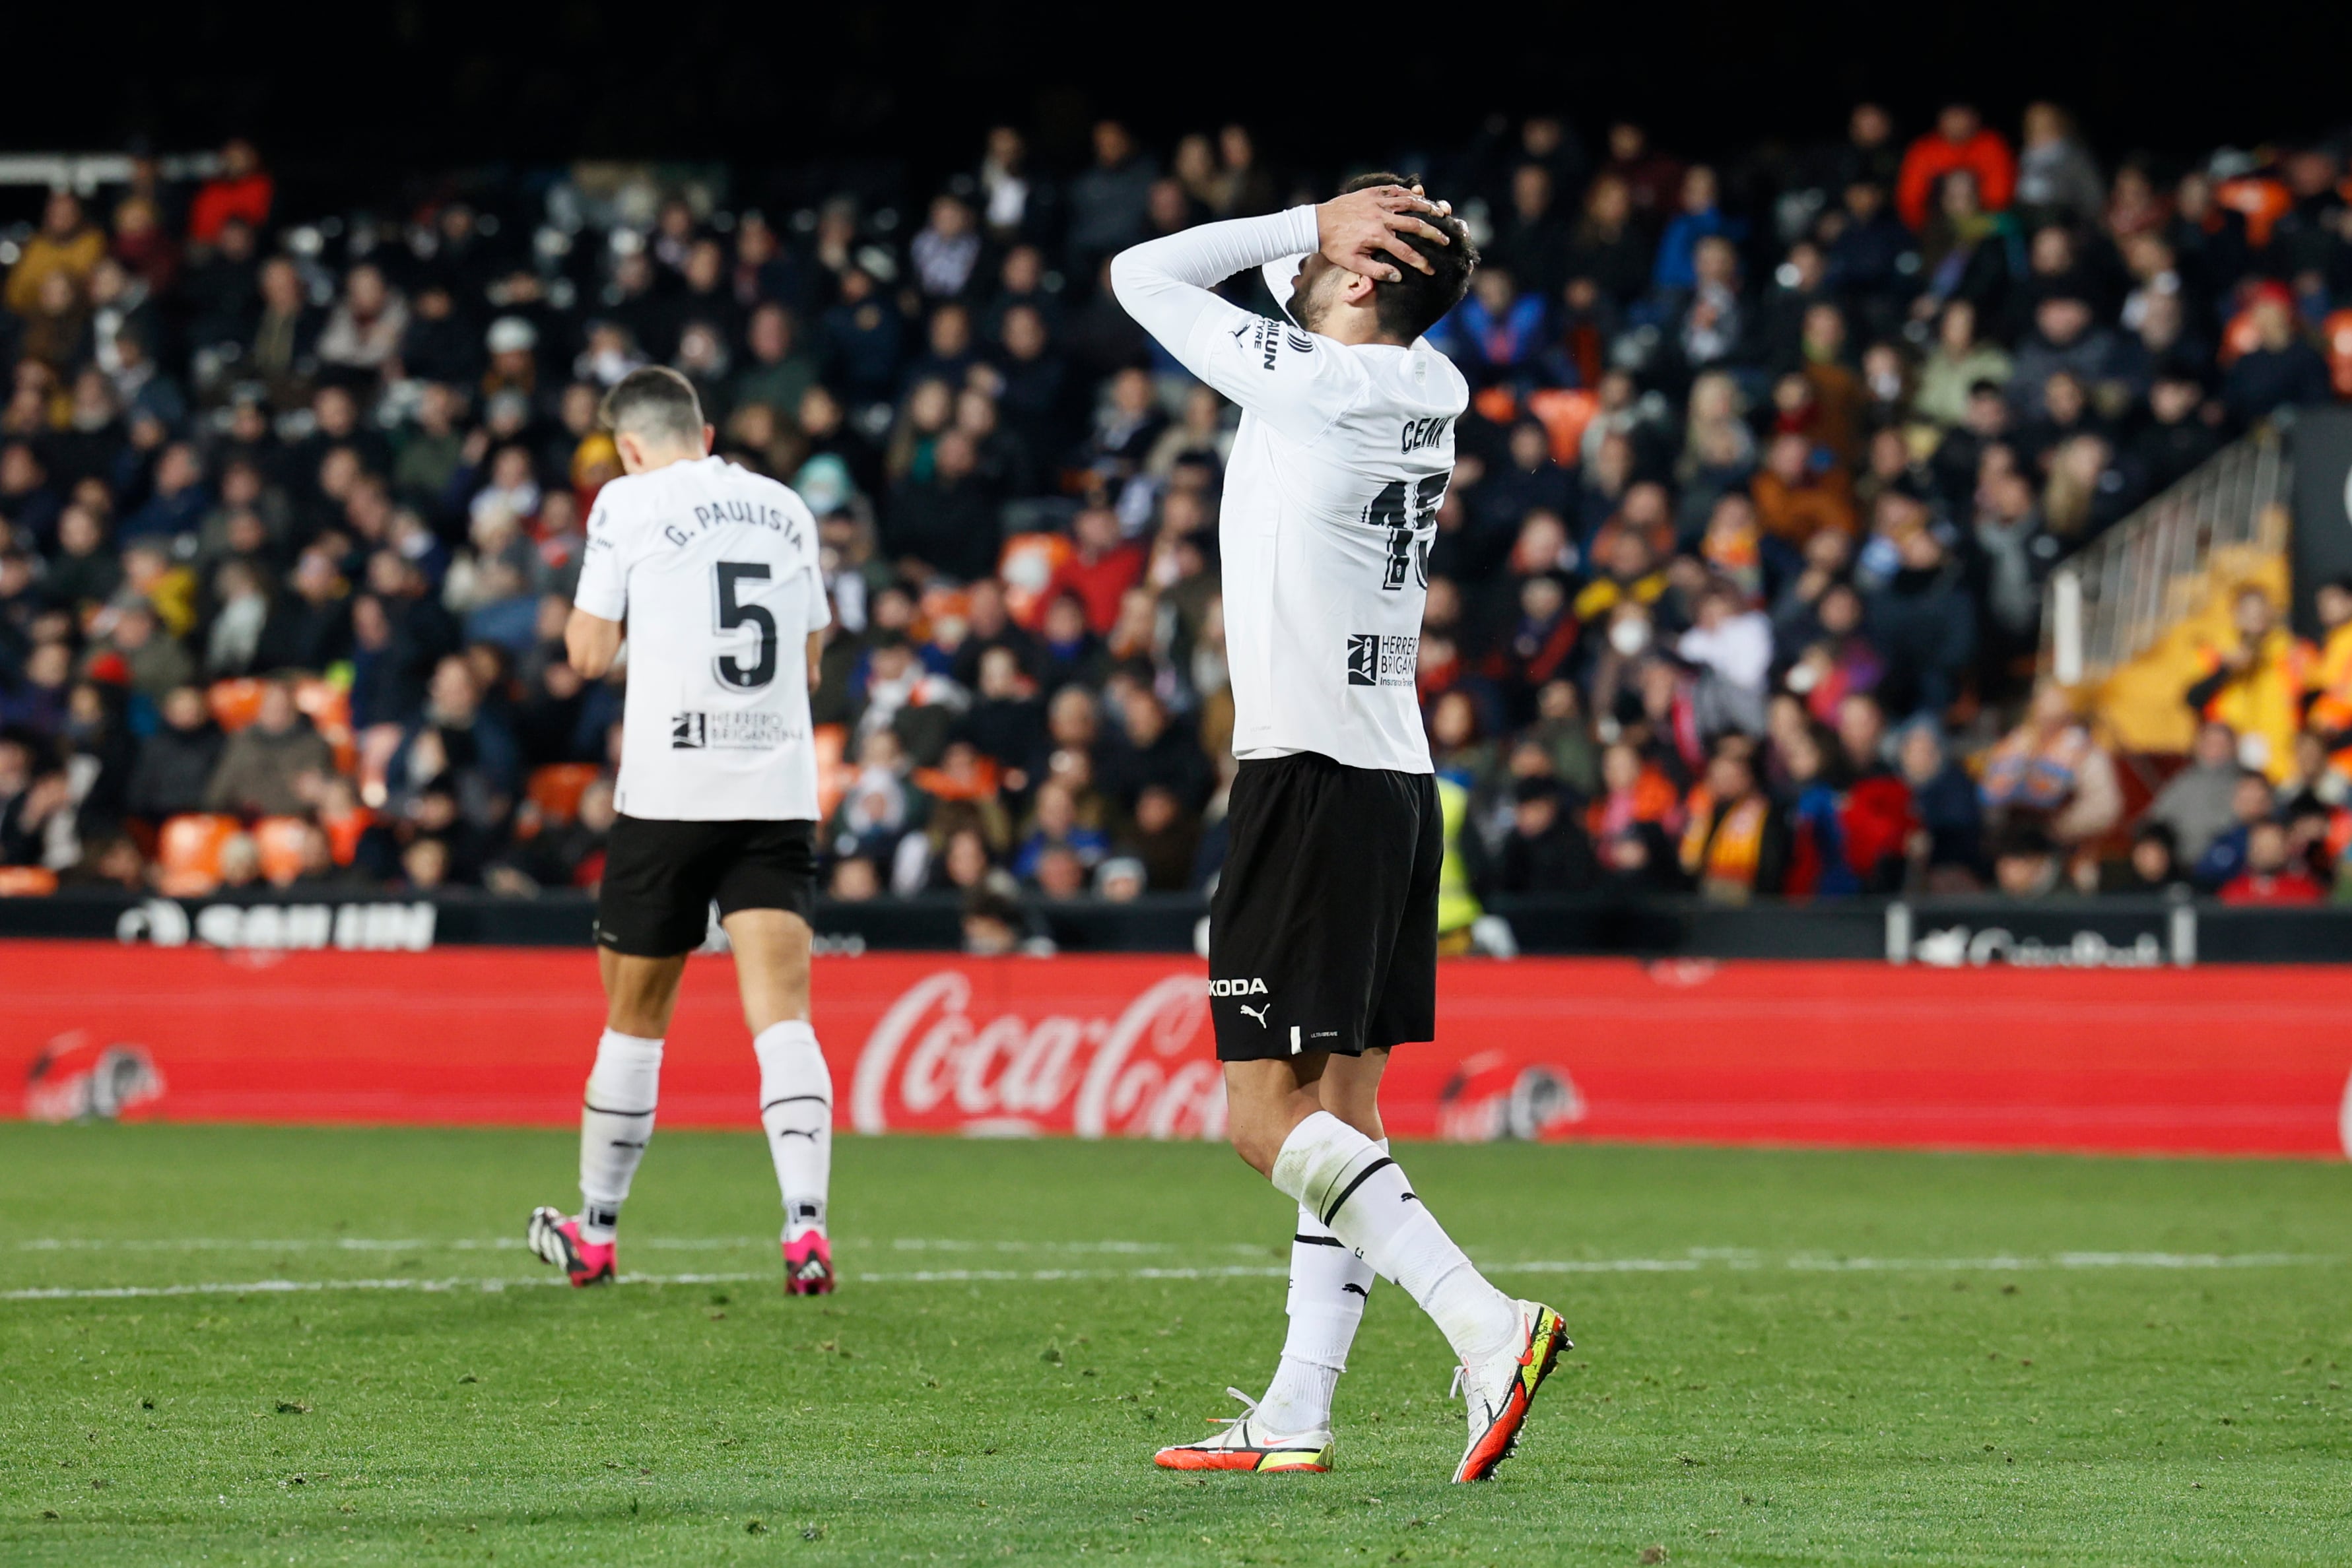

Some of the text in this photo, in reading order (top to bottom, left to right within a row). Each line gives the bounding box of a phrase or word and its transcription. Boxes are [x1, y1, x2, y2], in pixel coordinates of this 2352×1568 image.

[1254, 319, 1265, 350] TYRE
[1263, 320, 1280, 371] AILUN
[665, 501, 803, 552] G. PAULISTA
[711, 561, 778, 694] 5
[1381, 655, 1417, 674] BRIGAN
[1209, 977, 1268, 996] KODA
[850, 970, 1229, 1140] Coca-Co
